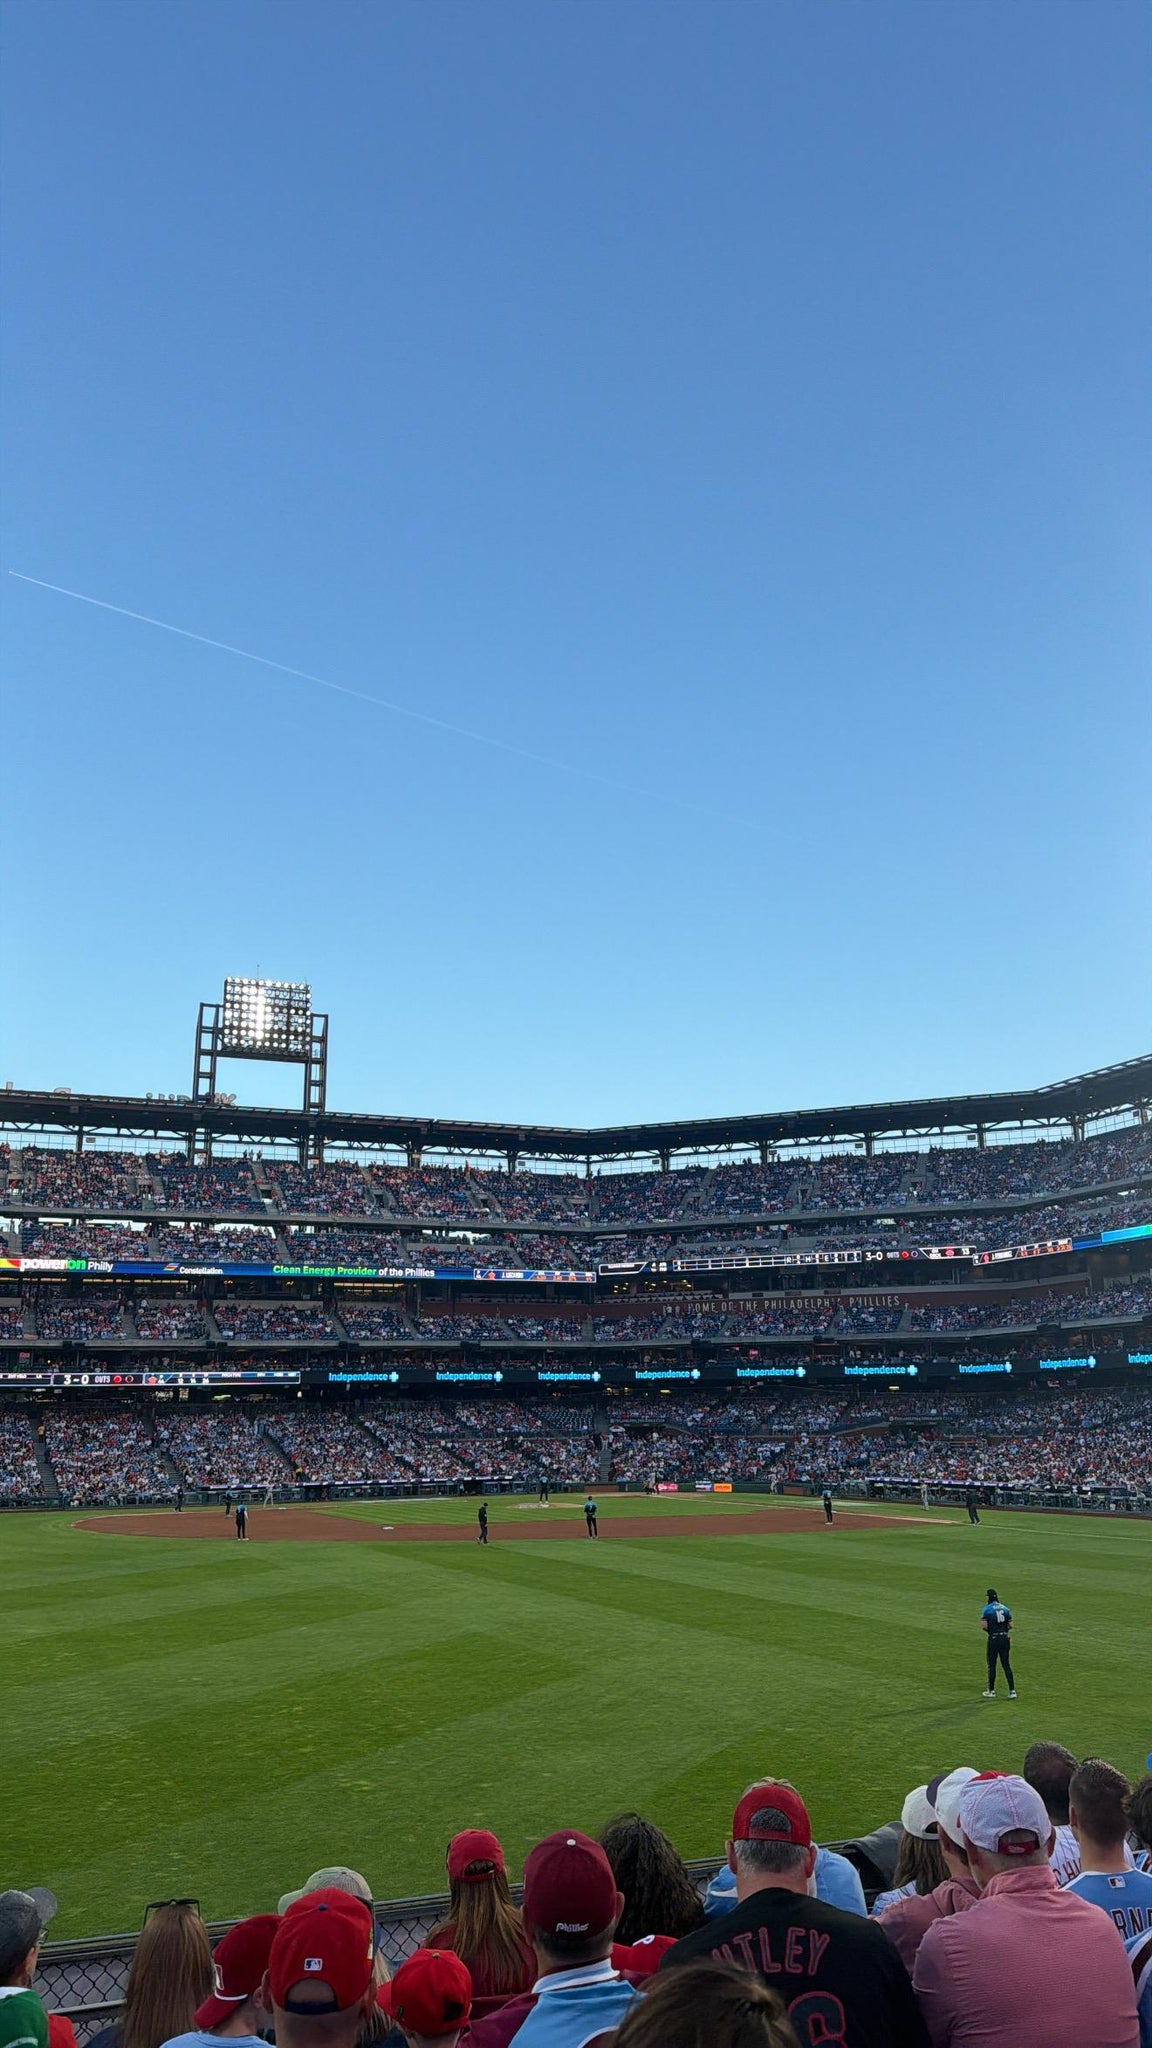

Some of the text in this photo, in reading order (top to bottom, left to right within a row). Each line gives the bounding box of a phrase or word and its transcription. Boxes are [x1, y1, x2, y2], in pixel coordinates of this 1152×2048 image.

[88, 1261, 114, 1272] Philly
[179, 1266, 224, 1275] Constellation
[273, 1265, 435, 1277] Clean Energy Provider of the Phillies
[764, 1297, 841, 1309] PHILADELPH
[959, 1363, 1005, 1374] Independence
[1040, 1357, 1088, 1370] Independence
[436, 1371, 493, 1382] Independence
[538, 1371, 591, 1382] Independence
[635, 1370, 690, 1380] Independence
[737, 1368, 795, 1378] Independence
[844, 1366, 906, 1376] Independence
[95, 1375, 111, 1383] OUTS
[329, 1372, 388, 1382] Independence
[996, 1610, 1005, 1623] 16
[556, 1923, 589, 1933] Phillies
